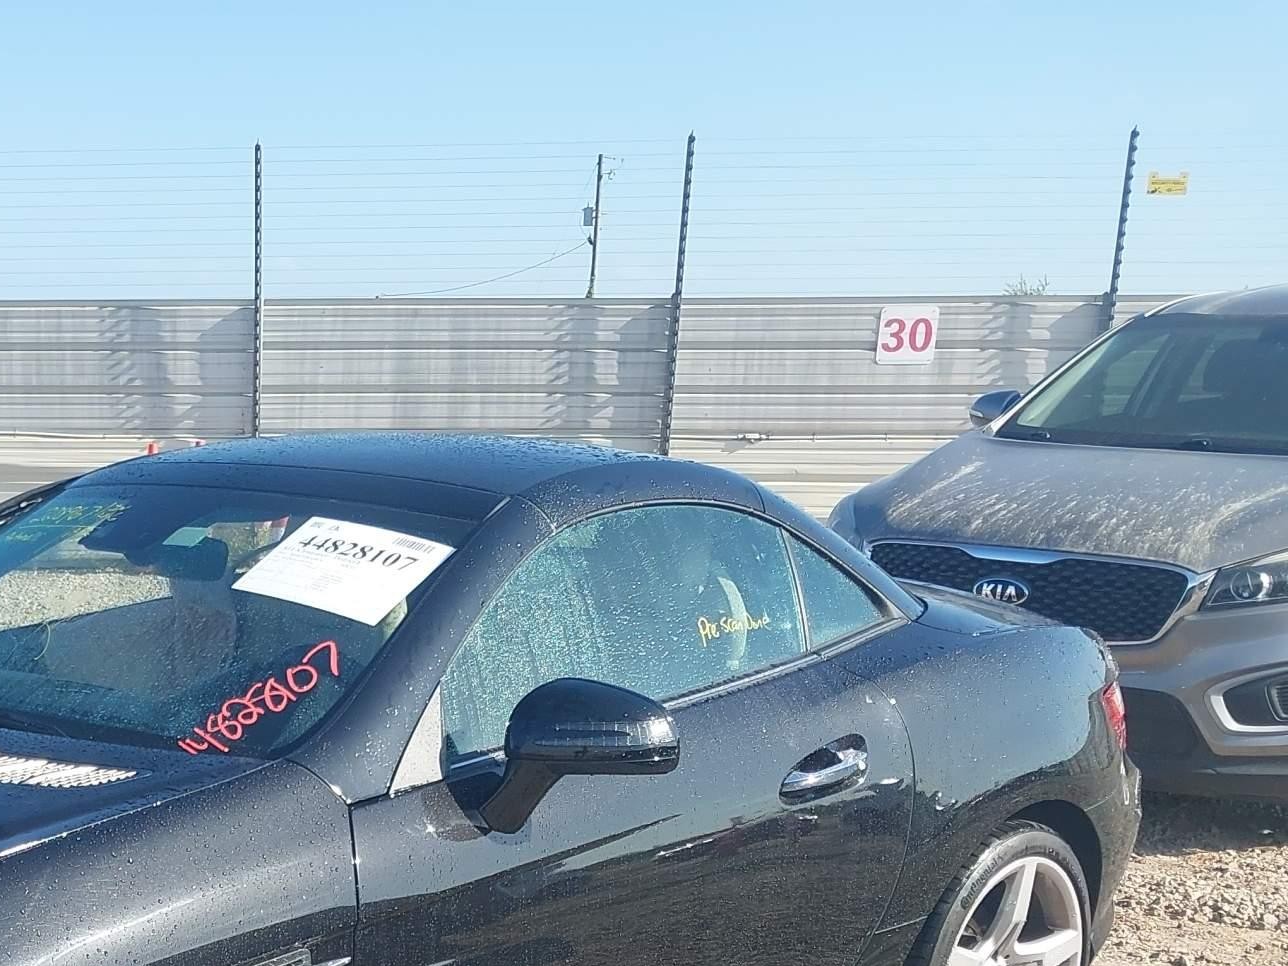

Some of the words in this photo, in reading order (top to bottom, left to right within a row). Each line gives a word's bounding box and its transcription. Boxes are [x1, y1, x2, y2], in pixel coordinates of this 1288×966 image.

[881, 318, 933, 353] 30
[298, 535, 420, 571] 44828107
[982, 582, 1018, 601] KIA
